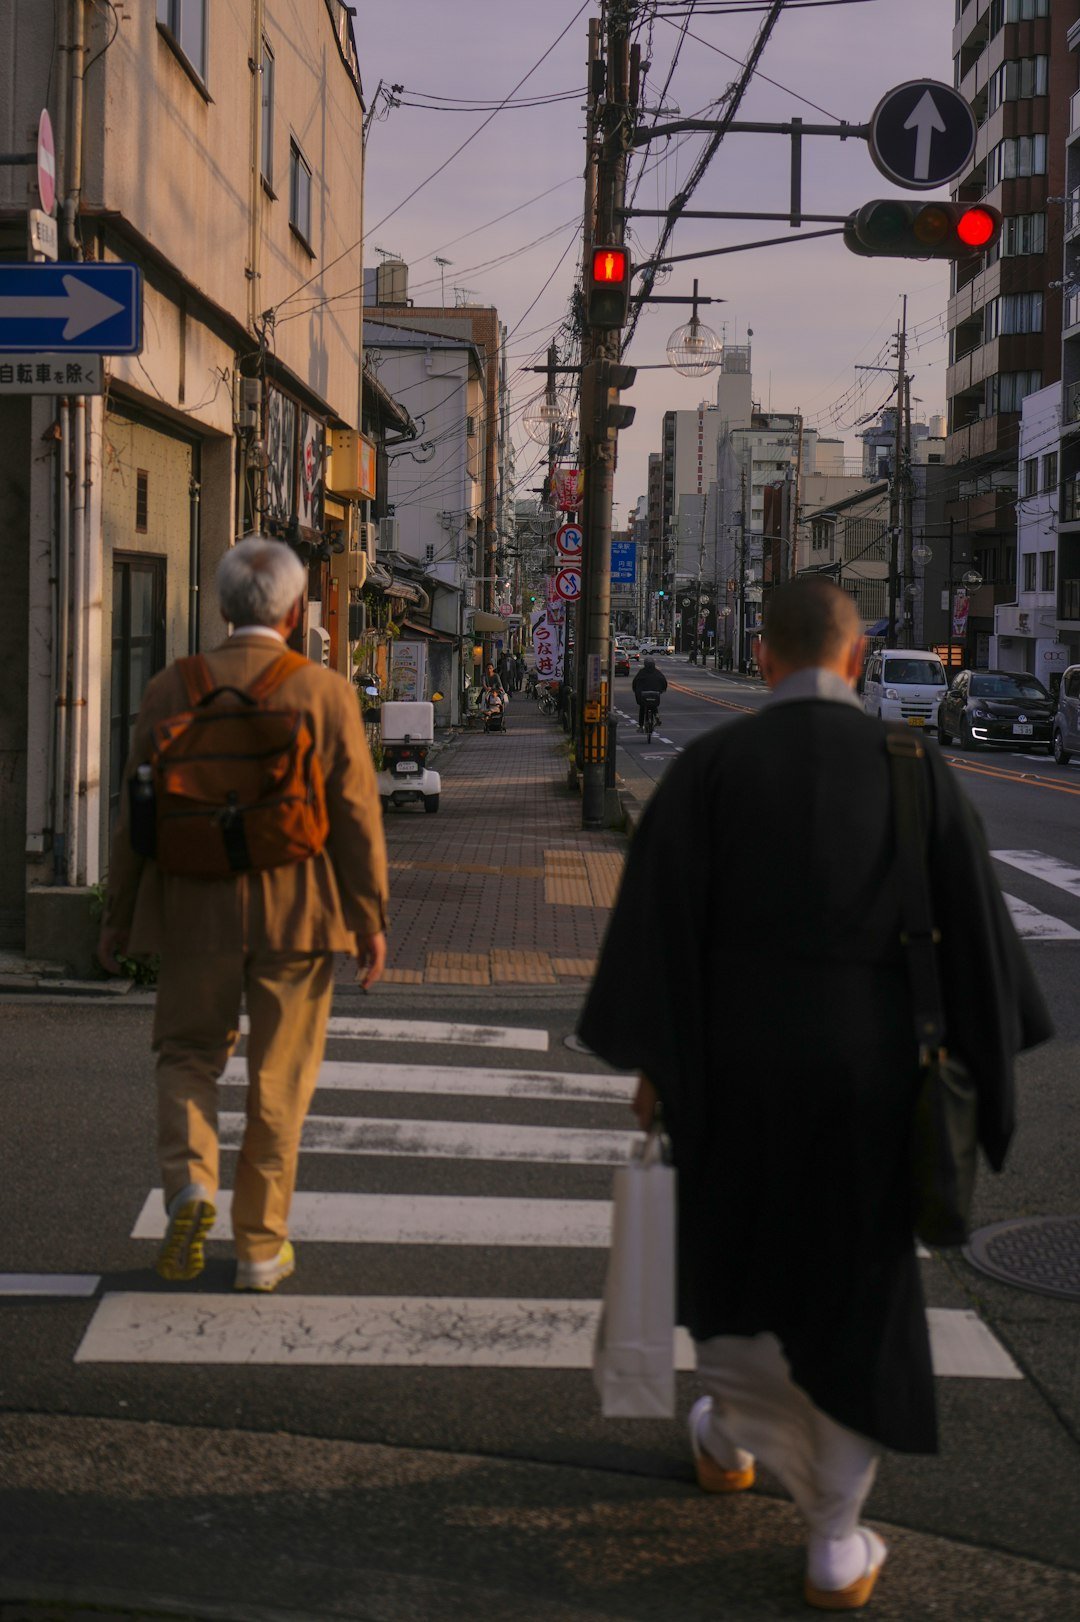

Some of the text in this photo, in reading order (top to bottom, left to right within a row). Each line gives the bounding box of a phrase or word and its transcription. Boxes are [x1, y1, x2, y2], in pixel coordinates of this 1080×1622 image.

[0, 363, 94, 384] 自転車を除く
[536, 627, 553, 671] うな丼
